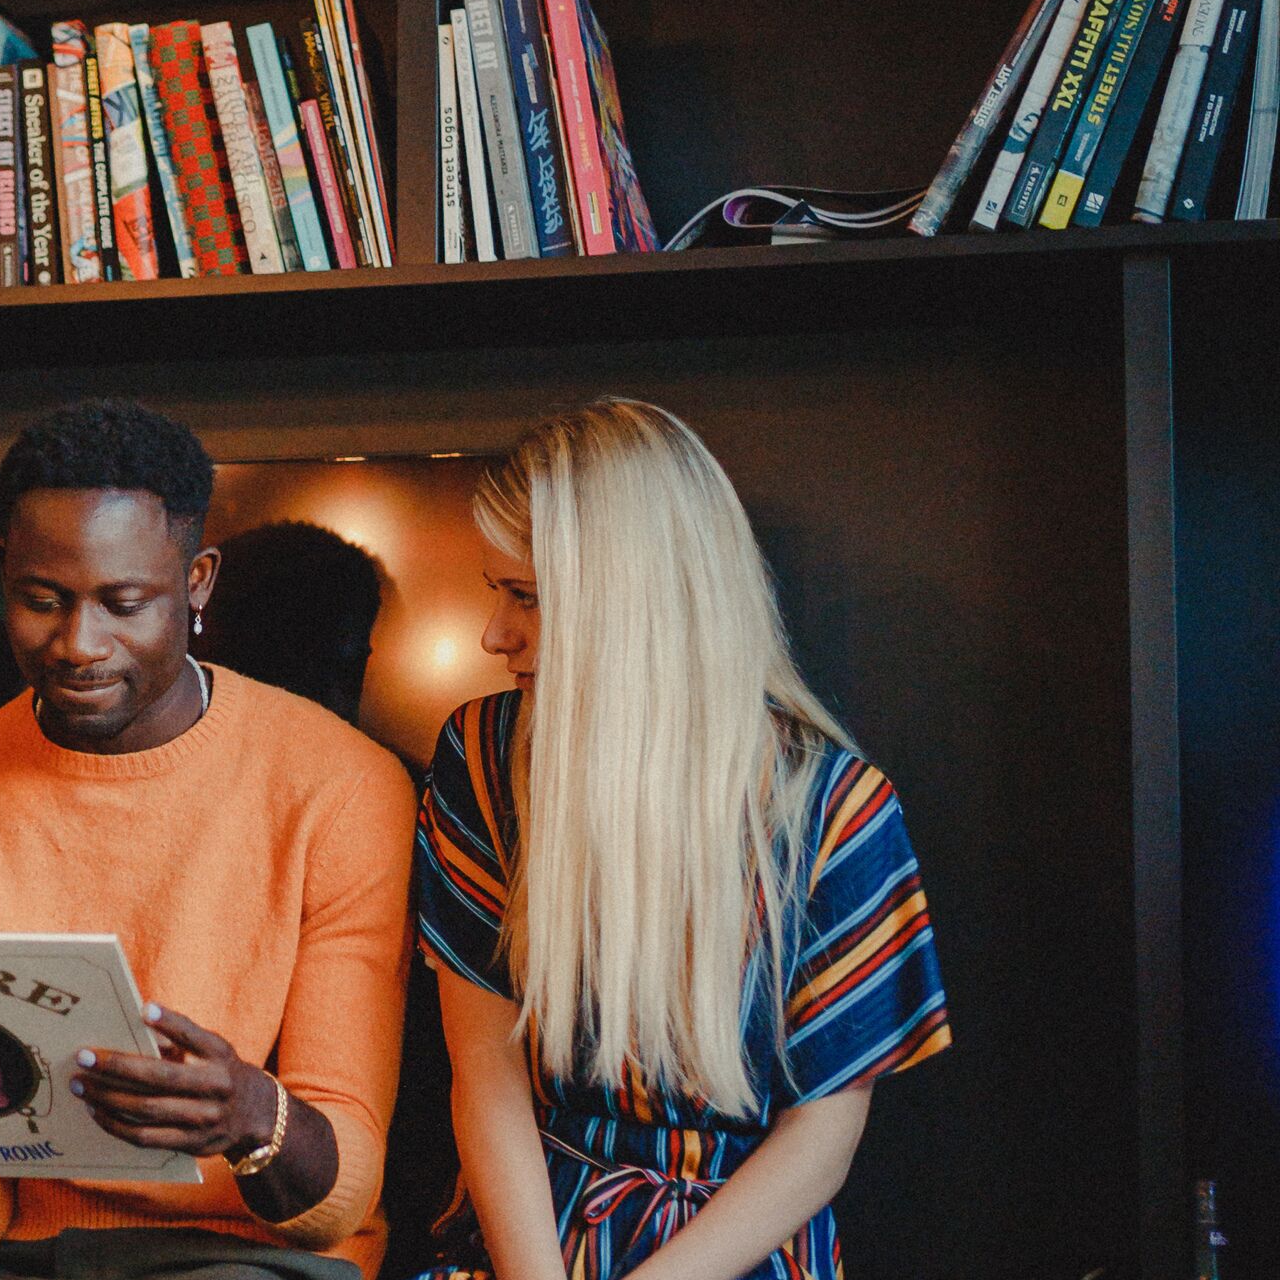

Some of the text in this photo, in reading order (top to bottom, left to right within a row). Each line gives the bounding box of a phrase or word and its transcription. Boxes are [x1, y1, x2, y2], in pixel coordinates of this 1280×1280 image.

[475, 42, 498, 69] ART
[320, 93, 335, 130] VINYL
[973, 63, 1013, 127] STREET ART
[1052, 70, 1082, 112] XXL
[1087, 64, 1120, 125] STREET
[86, 58, 113, 249] STREET ARTISTS THE COMPLETE GUIDE
[215, 77, 257, 234] SAN FRANCISCO
[221, 73, 261, 187] STREET ART
[442, 107, 456, 207] street logos
[528, 108, 552, 152] ART
[25, 94, 52, 266] Sneaker of the Year
[538, 154, 564, 235] STREET
[1018, 175, 1040, 209] PRESTEL
